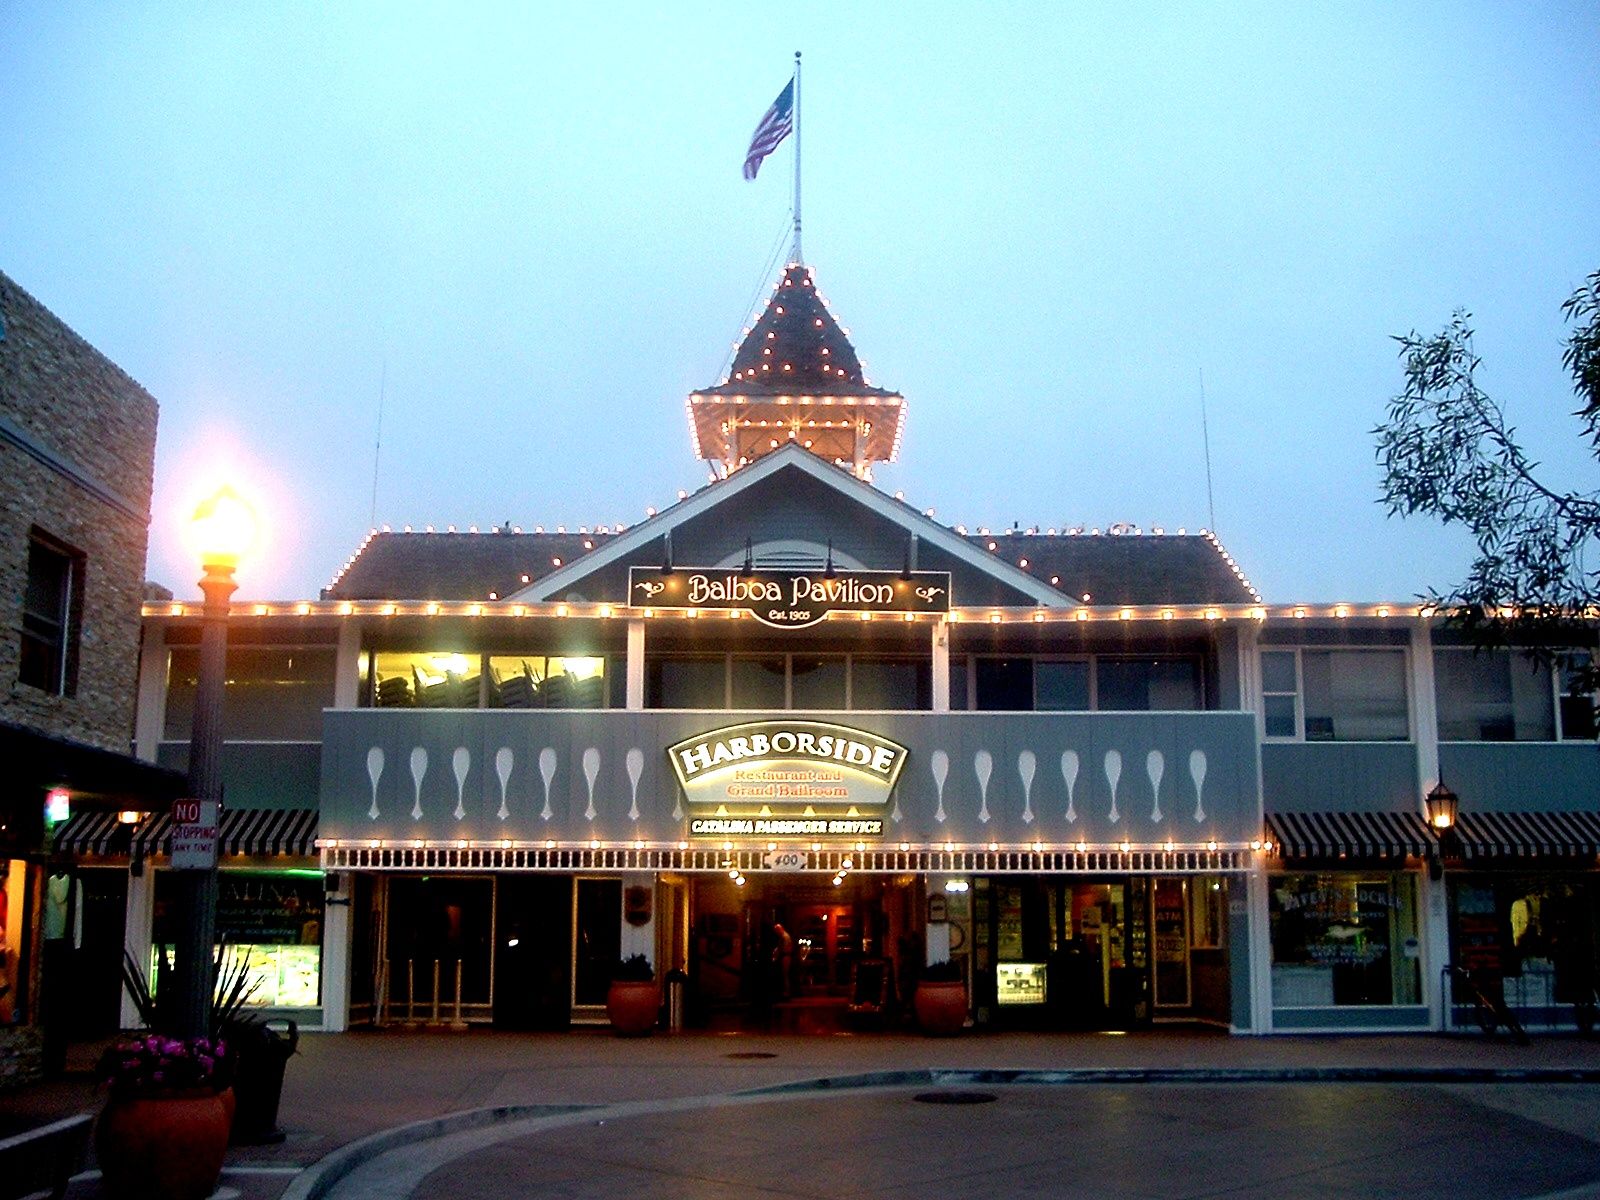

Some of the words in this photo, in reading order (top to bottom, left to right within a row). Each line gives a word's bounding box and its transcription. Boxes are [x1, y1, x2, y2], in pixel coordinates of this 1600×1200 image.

[688, 574, 782, 603] Balboa
[790, 576, 894, 606] Pavilion
[768, 609, 788, 620] Est.
[789, 610, 810, 621] 1905
[679, 732, 896, 775] HARBORSIDE
[734, 770, 815, 781] Restaurant
[817, 770, 842, 781] and
[727, 784, 774, 796] Grand
[778, 784, 848, 796] Ballroom
[176, 803, 198, 821] NO
[172, 826, 215, 839] STOPPING
[691, 820, 753, 834] CATALINA
[754, 820, 827, 834] PASSENGER
[828, 821, 882, 834] SERVICE
[775, 854, 798, 866] 400
